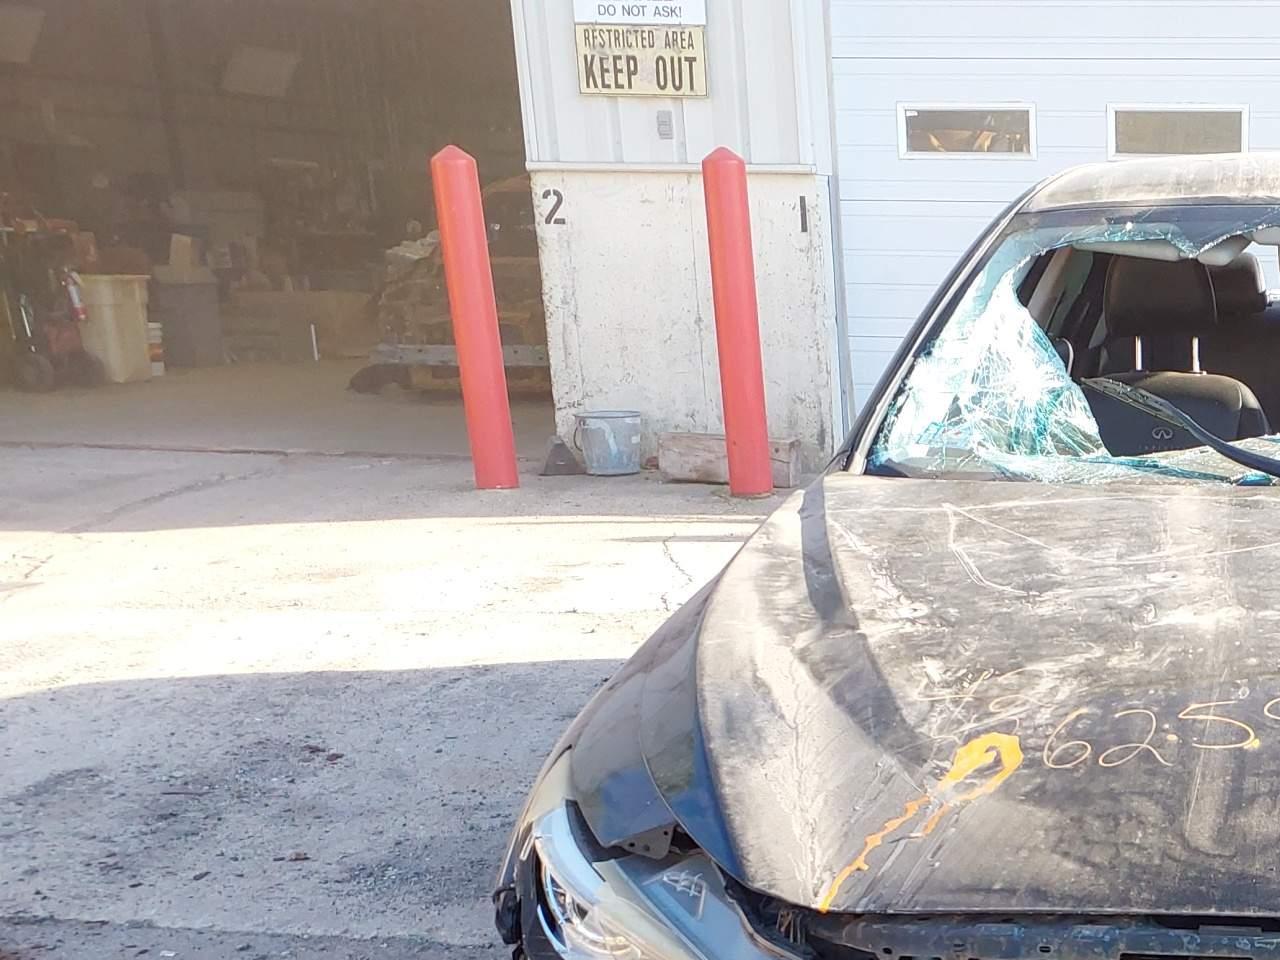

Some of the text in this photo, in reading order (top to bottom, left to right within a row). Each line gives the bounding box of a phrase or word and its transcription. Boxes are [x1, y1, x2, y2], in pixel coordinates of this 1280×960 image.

[597, 4, 682, 18] DO NOT ASK!
[583, 28, 695, 50] RESTRICTED AREA
[583, 54, 697, 92] KEEP OUT
[542, 189, 566, 225] 2
